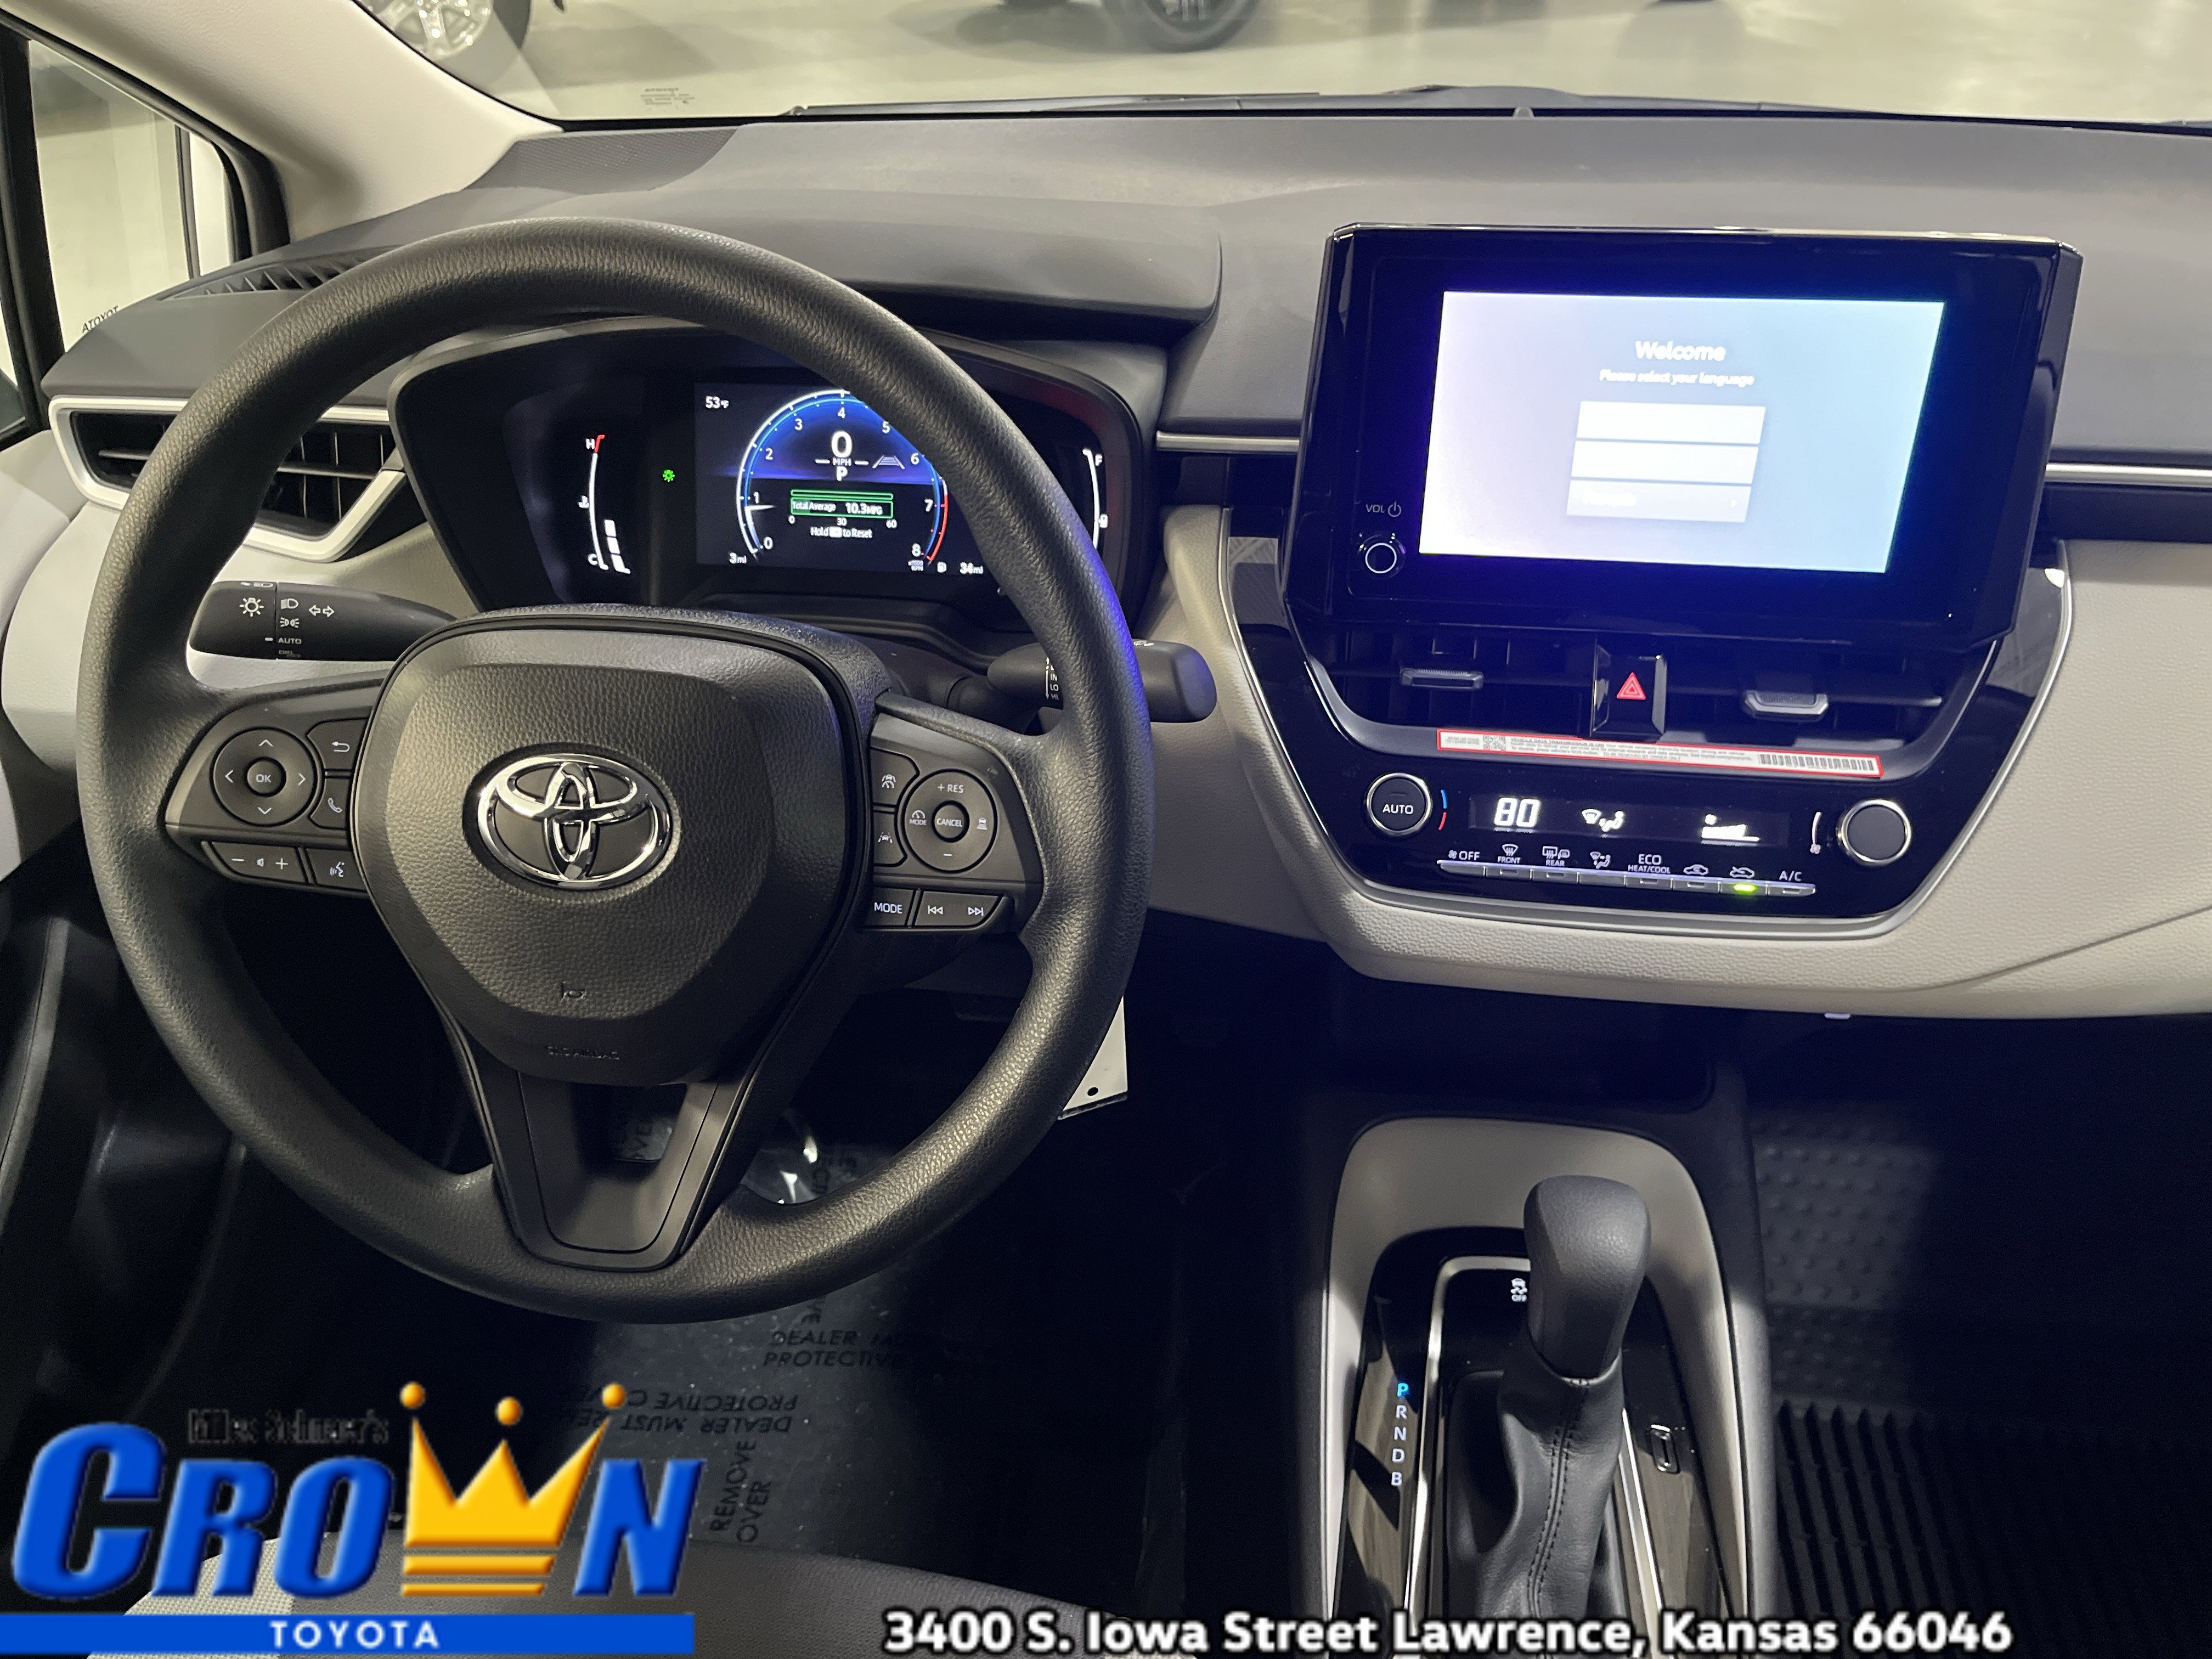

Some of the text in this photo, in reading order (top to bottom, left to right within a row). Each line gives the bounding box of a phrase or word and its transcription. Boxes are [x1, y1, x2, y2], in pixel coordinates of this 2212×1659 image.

[1635, 341, 1726, 361] Welcome
[1600, 369, 1754, 387] Please select your language
[837, 407, 845, 419] 4
[795, 419, 803, 431] 3
[882, 421, 890, 433] 5
[585, 438, 595, 449] H
[831, 430, 853, 458] 0
[765, 448, 773, 460] 2
[910, 453, 919, 465] 6
[1094, 454, 1102, 466] F
[833, 458, 851, 466] MPH
[836, 466, 848, 481] P
[753, 492, 760, 504] 1
[792, 501, 809, 510] Total
[809, 501, 837, 512] Average
[924, 499, 933, 512] 7
[1365, 504, 1385, 514] VOL
[788, 515, 897, 528] 0 30 60
[810, 527, 829, 537] Hold
[843, 528, 851, 537] to
[851, 528, 873, 539] Reset
[764, 537, 773, 549] 0
[912, 543, 921, 557] 8
[588, 554, 597, 566] C
[256, 774, 272, 783] OK
[947, 784, 964, 793] RES
[1383, 804, 1414, 815] AUTO
[1493, 797, 1541, 828] 80
[936, 818, 963, 827] CANCEL
[1459, 851, 1480, 861] OFF
[1497, 856, 1521, 865] FRONT
[1638, 854, 1662, 866] ECO
[1545, 859, 1565, 867] REAR
[1628, 865, 1671, 874] HEAT/COOL
[1779, 871, 1802, 882] A/C
[874, 902, 902, 914] MODE
[769, 1330, 857, 1347] DEALER
[763, 1350, 900, 1368] PROTECTIV
[1397, 1383, 1409, 1397] P
[652, 1392, 798, 1412] PROTECTIVE
[1396, 1405, 1407, 1419] R
[620, 1414, 684, 1431] MUST
[700, 1416, 792, 1434] DEALER
[1394, 1426, 1407, 1441] N
[1392, 1448, 1406, 1463] D
[1391, 1471, 1402, 1486] B
[709, 1440, 757, 1531] REMOVE
